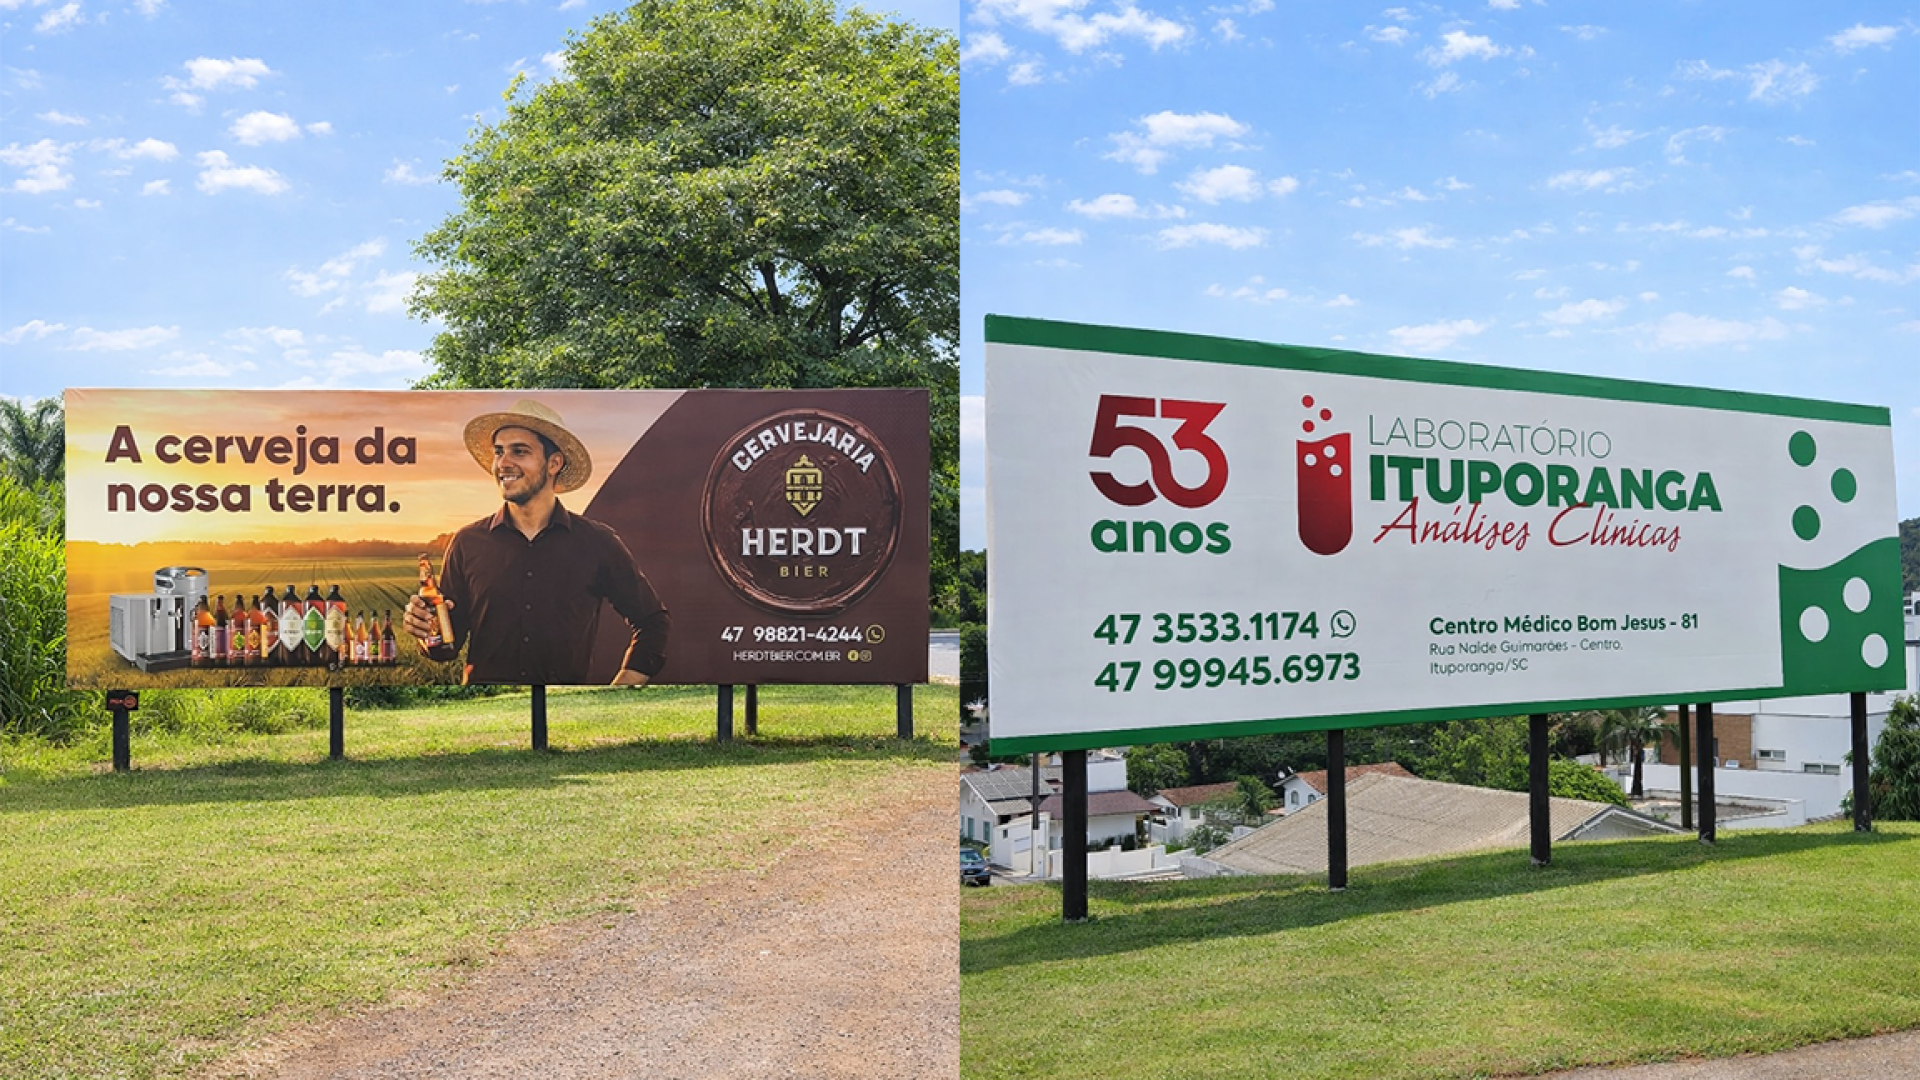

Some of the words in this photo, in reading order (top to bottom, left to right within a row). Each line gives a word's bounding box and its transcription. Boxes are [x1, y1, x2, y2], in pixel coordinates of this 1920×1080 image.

[104, 423, 142, 464] A
[154, 423, 339, 475] cerveja
[354, 425, 417, 465] da
[731, 421, 876, 474] CERVEJARIA
[1088, 394, 1229, 509] 53
[1368, 413, 1612, 460] LABORATÓRIO
[106, 481, 251, 513] nossa
[264, 477, 401, 513] terra.
[1368, 453, 1723, 512] ITUPORANGA
[740, 526, 868, 557] HERDT
[1089, 518, 1232, 556] anos
[1372, 495, 1531, 551] Análises
[1547, 500, 1682, 552] Clínicas
[778, 564, 830, 579] BIER
[720, 625, 744, 643] 47
[752, 625, 863, 643] 98821-4244
[1092, 613, 1142, 646] 47
[1151, 610, 1319, 645] 3533.1174
[1428, 616, 1499, 636] Centro
[1503, 613, 1573, 634] Médico
[1576, 613, 1617, 633] Bom
[1619, 613, 1667, 632] Jesus
[1680, 612, 1699, 630] 81
[1428, 641, 1456, 656] Rua
[1429, 657, 1530, 677] Ituporanga/SC
[1093, 660, 1142, 693] 47
[1152, 651, 1361, 691] 99945.6973
